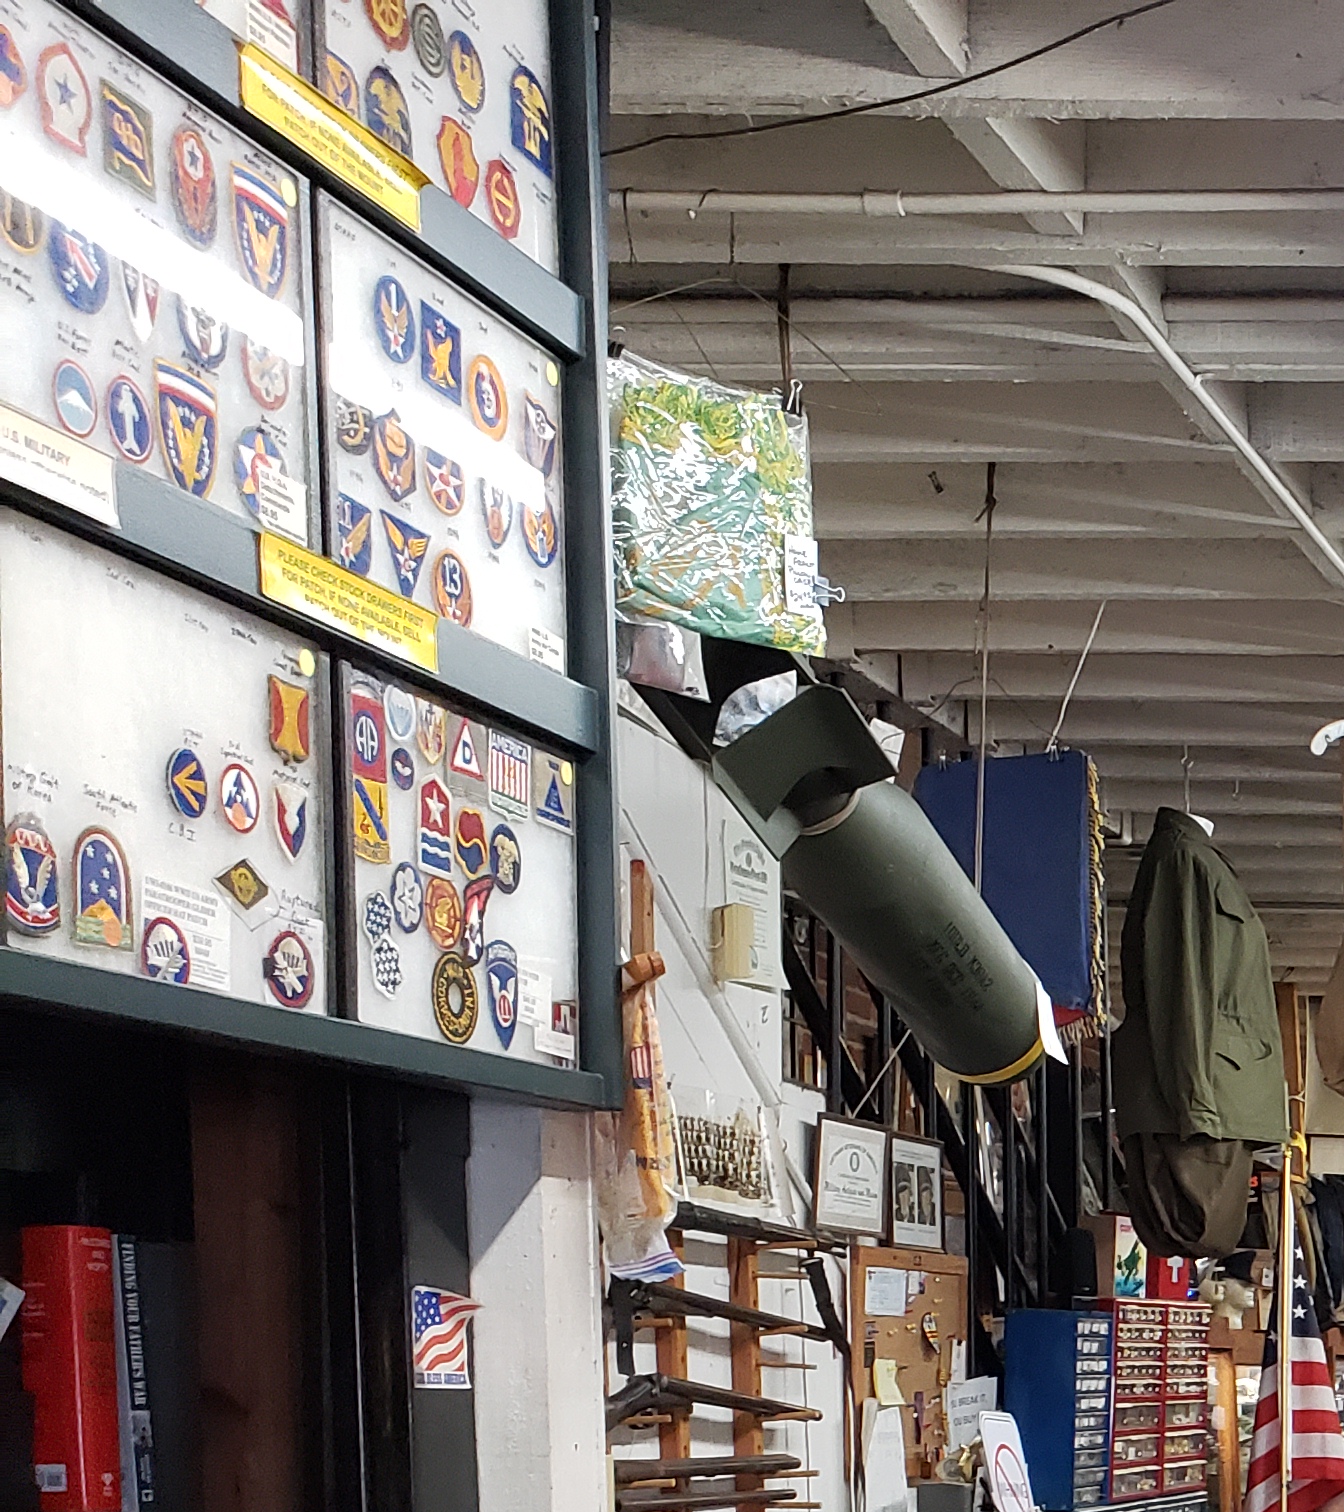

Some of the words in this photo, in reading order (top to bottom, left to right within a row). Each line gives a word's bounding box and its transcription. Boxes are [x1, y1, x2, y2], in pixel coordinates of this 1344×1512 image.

[24, 435, 71, 467] MILITARY
[278, 549, 310, 574] PLEASE
[310, 564, 338, 586] CHECK
[339, 576, 364, 597] STOCK
[281, 567, 299, 583] FOR
[490, 731, 529, 762] AMERICA
[121, 1242, 138, 1291] FINDING
[124, 1291, 141, 1325] YOUR
[132, 1381, 147, 1406] WAR
